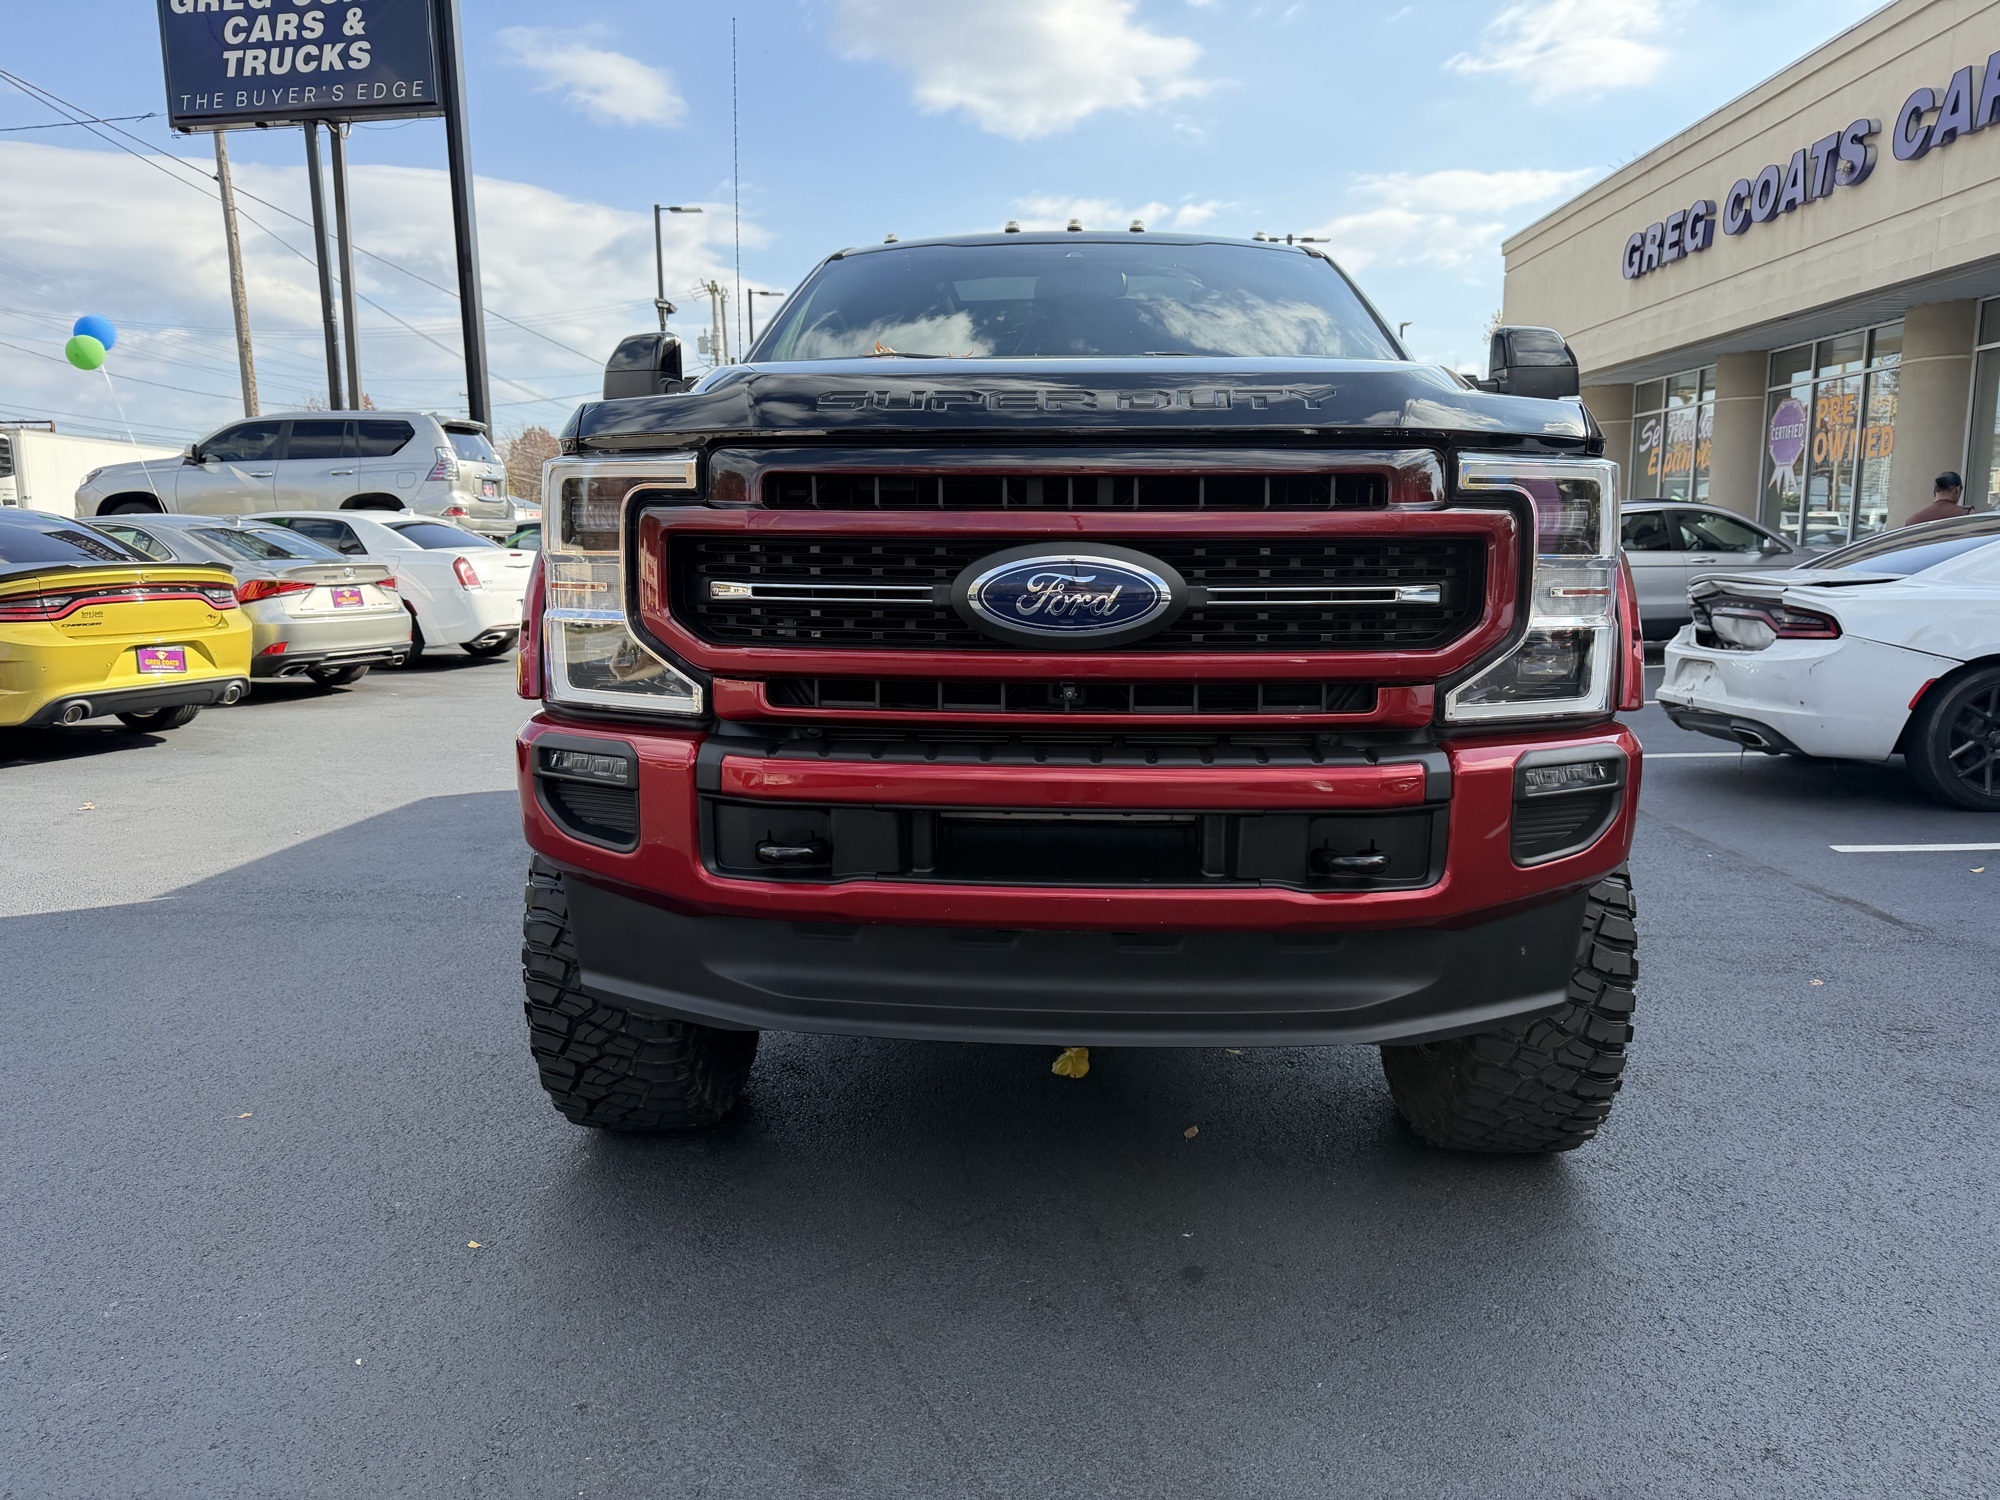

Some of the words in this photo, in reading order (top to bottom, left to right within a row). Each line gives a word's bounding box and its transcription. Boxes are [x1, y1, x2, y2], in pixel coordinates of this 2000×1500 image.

[224, 10, 325, 45] CARS
[342, 7, 366, 37] &
[222, 40, 372, 78] TRUCKS
[180, 92, 224, 111] THE
[236, 84, 344, 107] BUYER'S
[357, 80, 424, 100] EDGE
[1622, 200, 1717, 280] GREG
[1723, 118, 1881, 236] COATS
[816, 389, 1098, 412] SUPER
[1117, 386, 1338, 411] DUTY
[1771, 423, 1804, 440] CERTIFIED
[1015, 572, 1124, 618] Ford
